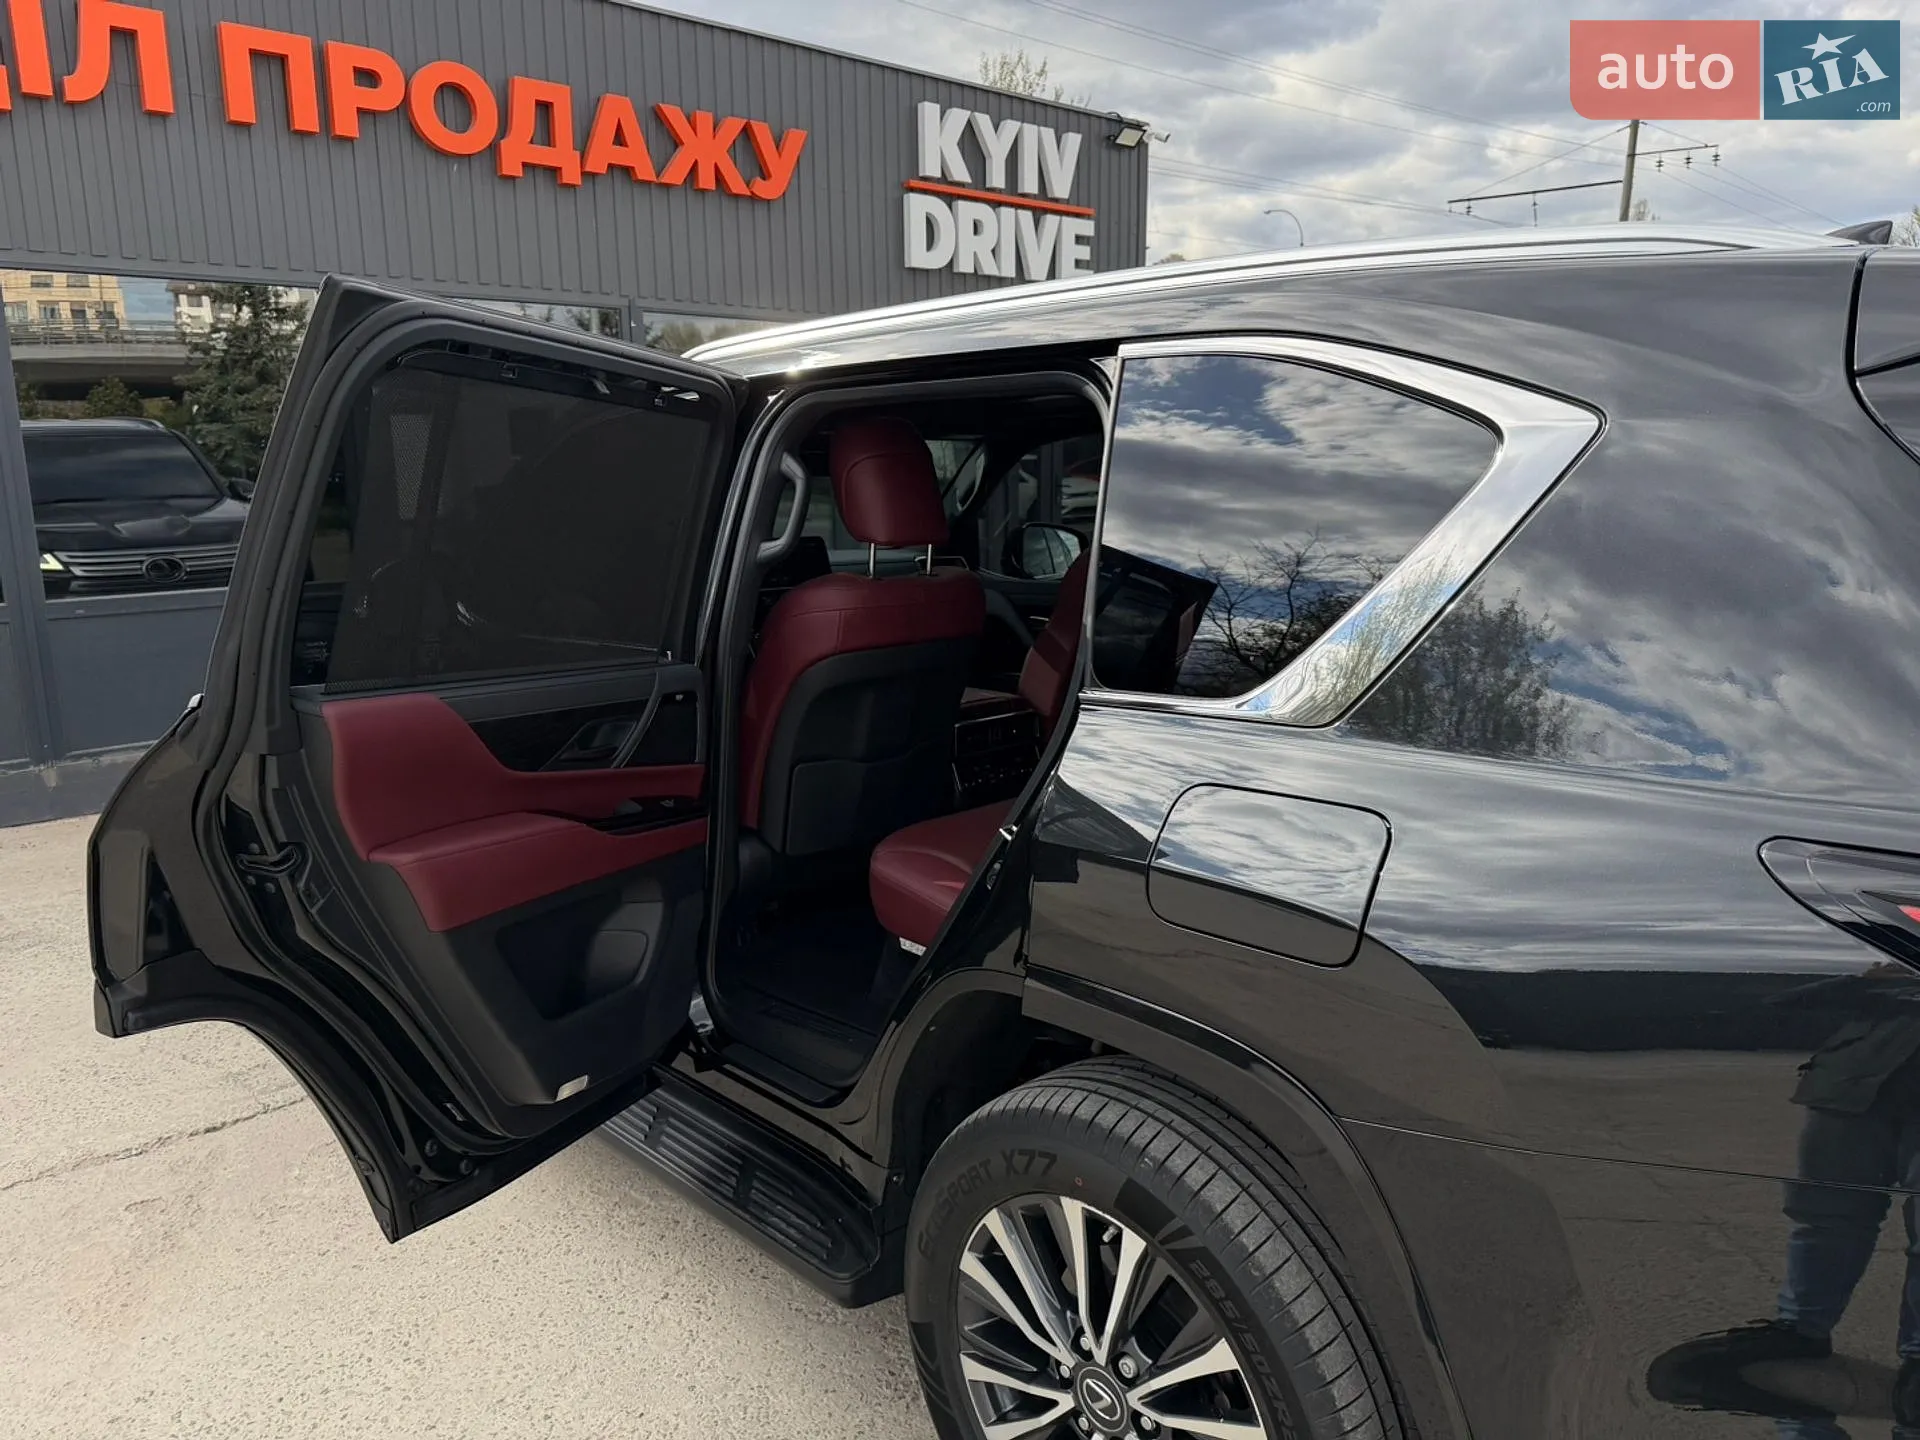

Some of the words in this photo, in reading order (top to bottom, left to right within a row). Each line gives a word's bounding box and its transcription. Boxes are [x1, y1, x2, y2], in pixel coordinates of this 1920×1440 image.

[217, 20, 807, 200] ПРОДАЖУ
[917, 100, 1083, 200] KYIV
[903, 192, 1095, 282] DRIVE
[1000, 1148, 1058, 1181] X77
